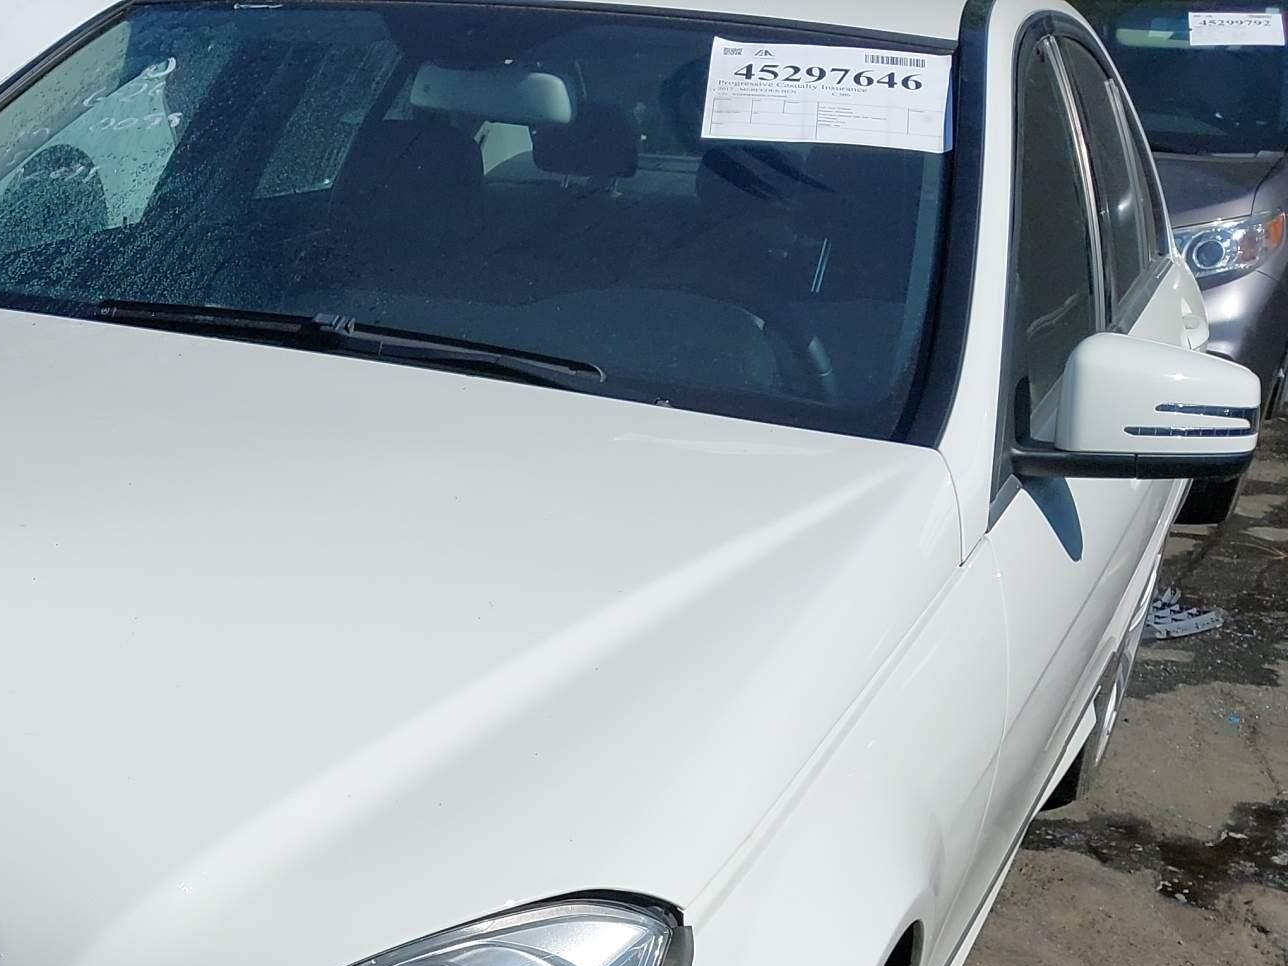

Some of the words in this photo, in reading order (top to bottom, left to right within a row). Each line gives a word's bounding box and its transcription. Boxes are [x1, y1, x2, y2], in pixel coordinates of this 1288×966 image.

[718, 79, 774, 88] Progressive
[776, 81, 817, 90] Casualty
[821, 84, 868, 93] Insurance
[734, 63, 923, 90] 45297646
